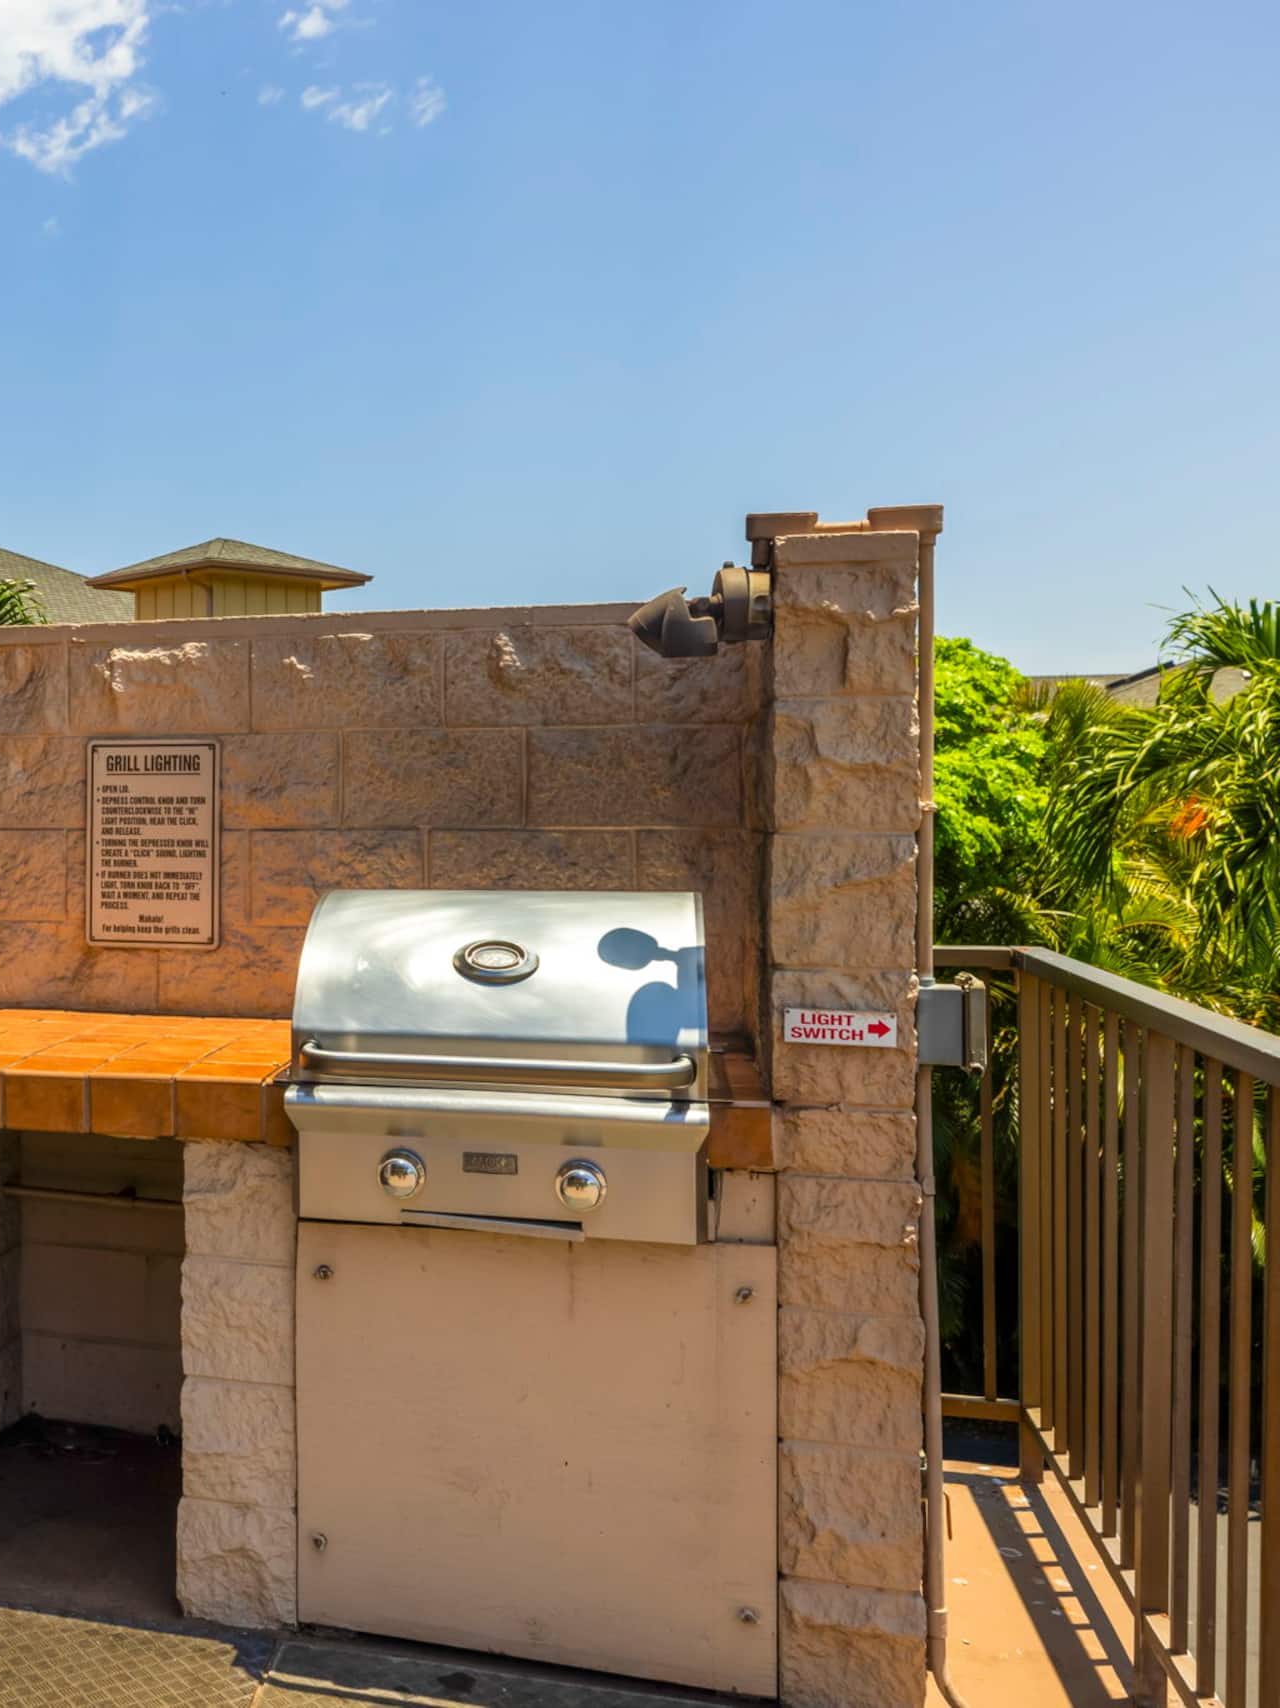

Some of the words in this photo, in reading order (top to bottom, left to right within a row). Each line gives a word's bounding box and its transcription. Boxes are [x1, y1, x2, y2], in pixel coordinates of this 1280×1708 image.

[106, 755, 140, 772] GRILL
[144, 754, 200, 772] LIGHTING
[102, 785, 117, 793] OPEN
[102, 796, 128, 804] DEPRESS
[130, 796, 155, 804] CONTROL
[158, 796, 174, 805] KNOB
[176, 797, 188, 805] AND
[190, 797, 206, 805] TURN
[102, 806, 162, 815] COUNTERCLOCKWISE
[164, 807, 171, 815] TO
[174, 807, 184, 815] THE
[102, 817, 117, 825] LIGHT
[150, 817, 165, 825] HEAR
[167, 817, 177, 825] THE
[102, 827, 114, 835] AND
[102, 839, 126, 847] TURNING
[128, 839, 138, 847] THE
[141, 839, 175, 847] DEPRESSED
[177, 839, 192, 847] KNOB
[195, 839, 208, 848] WILL
[101, 849, 122, 857] CREATE
[125, 849, 128, 857] A
[130, 849, 153, 857] "CLICK"
[179, 850, 206, 858] LIGHTING
[101, 859, 111, 867] THE
[101, 871, 106, 879] IF
[108, 871, 131, 879] BURNER
[163, 872, 202, 880] IMMEDIATELY
[120, 881, 135, 889] TURN
[173, 882, 179, 890] TO
[101, 891, 115, 899] WAIT
[123, 892, 150, 900] MOMENT,
[152, 892, 164, 900] AND
[166, 892, 187, 900] REPEAT
[190, 893, 200, 901] THE
[102, 924, 112, 932] For
[113, 925, 135, 934] helping
[137, 925, 152, 934] keep
[153, 925, 163, 933] the
[165, 926, 180, 934] grills
[182, 926, 200, 934] clean.
[801, 1013, 854, 1026] LIGHT
[791, 1027, 864, 1040] SWITCH
